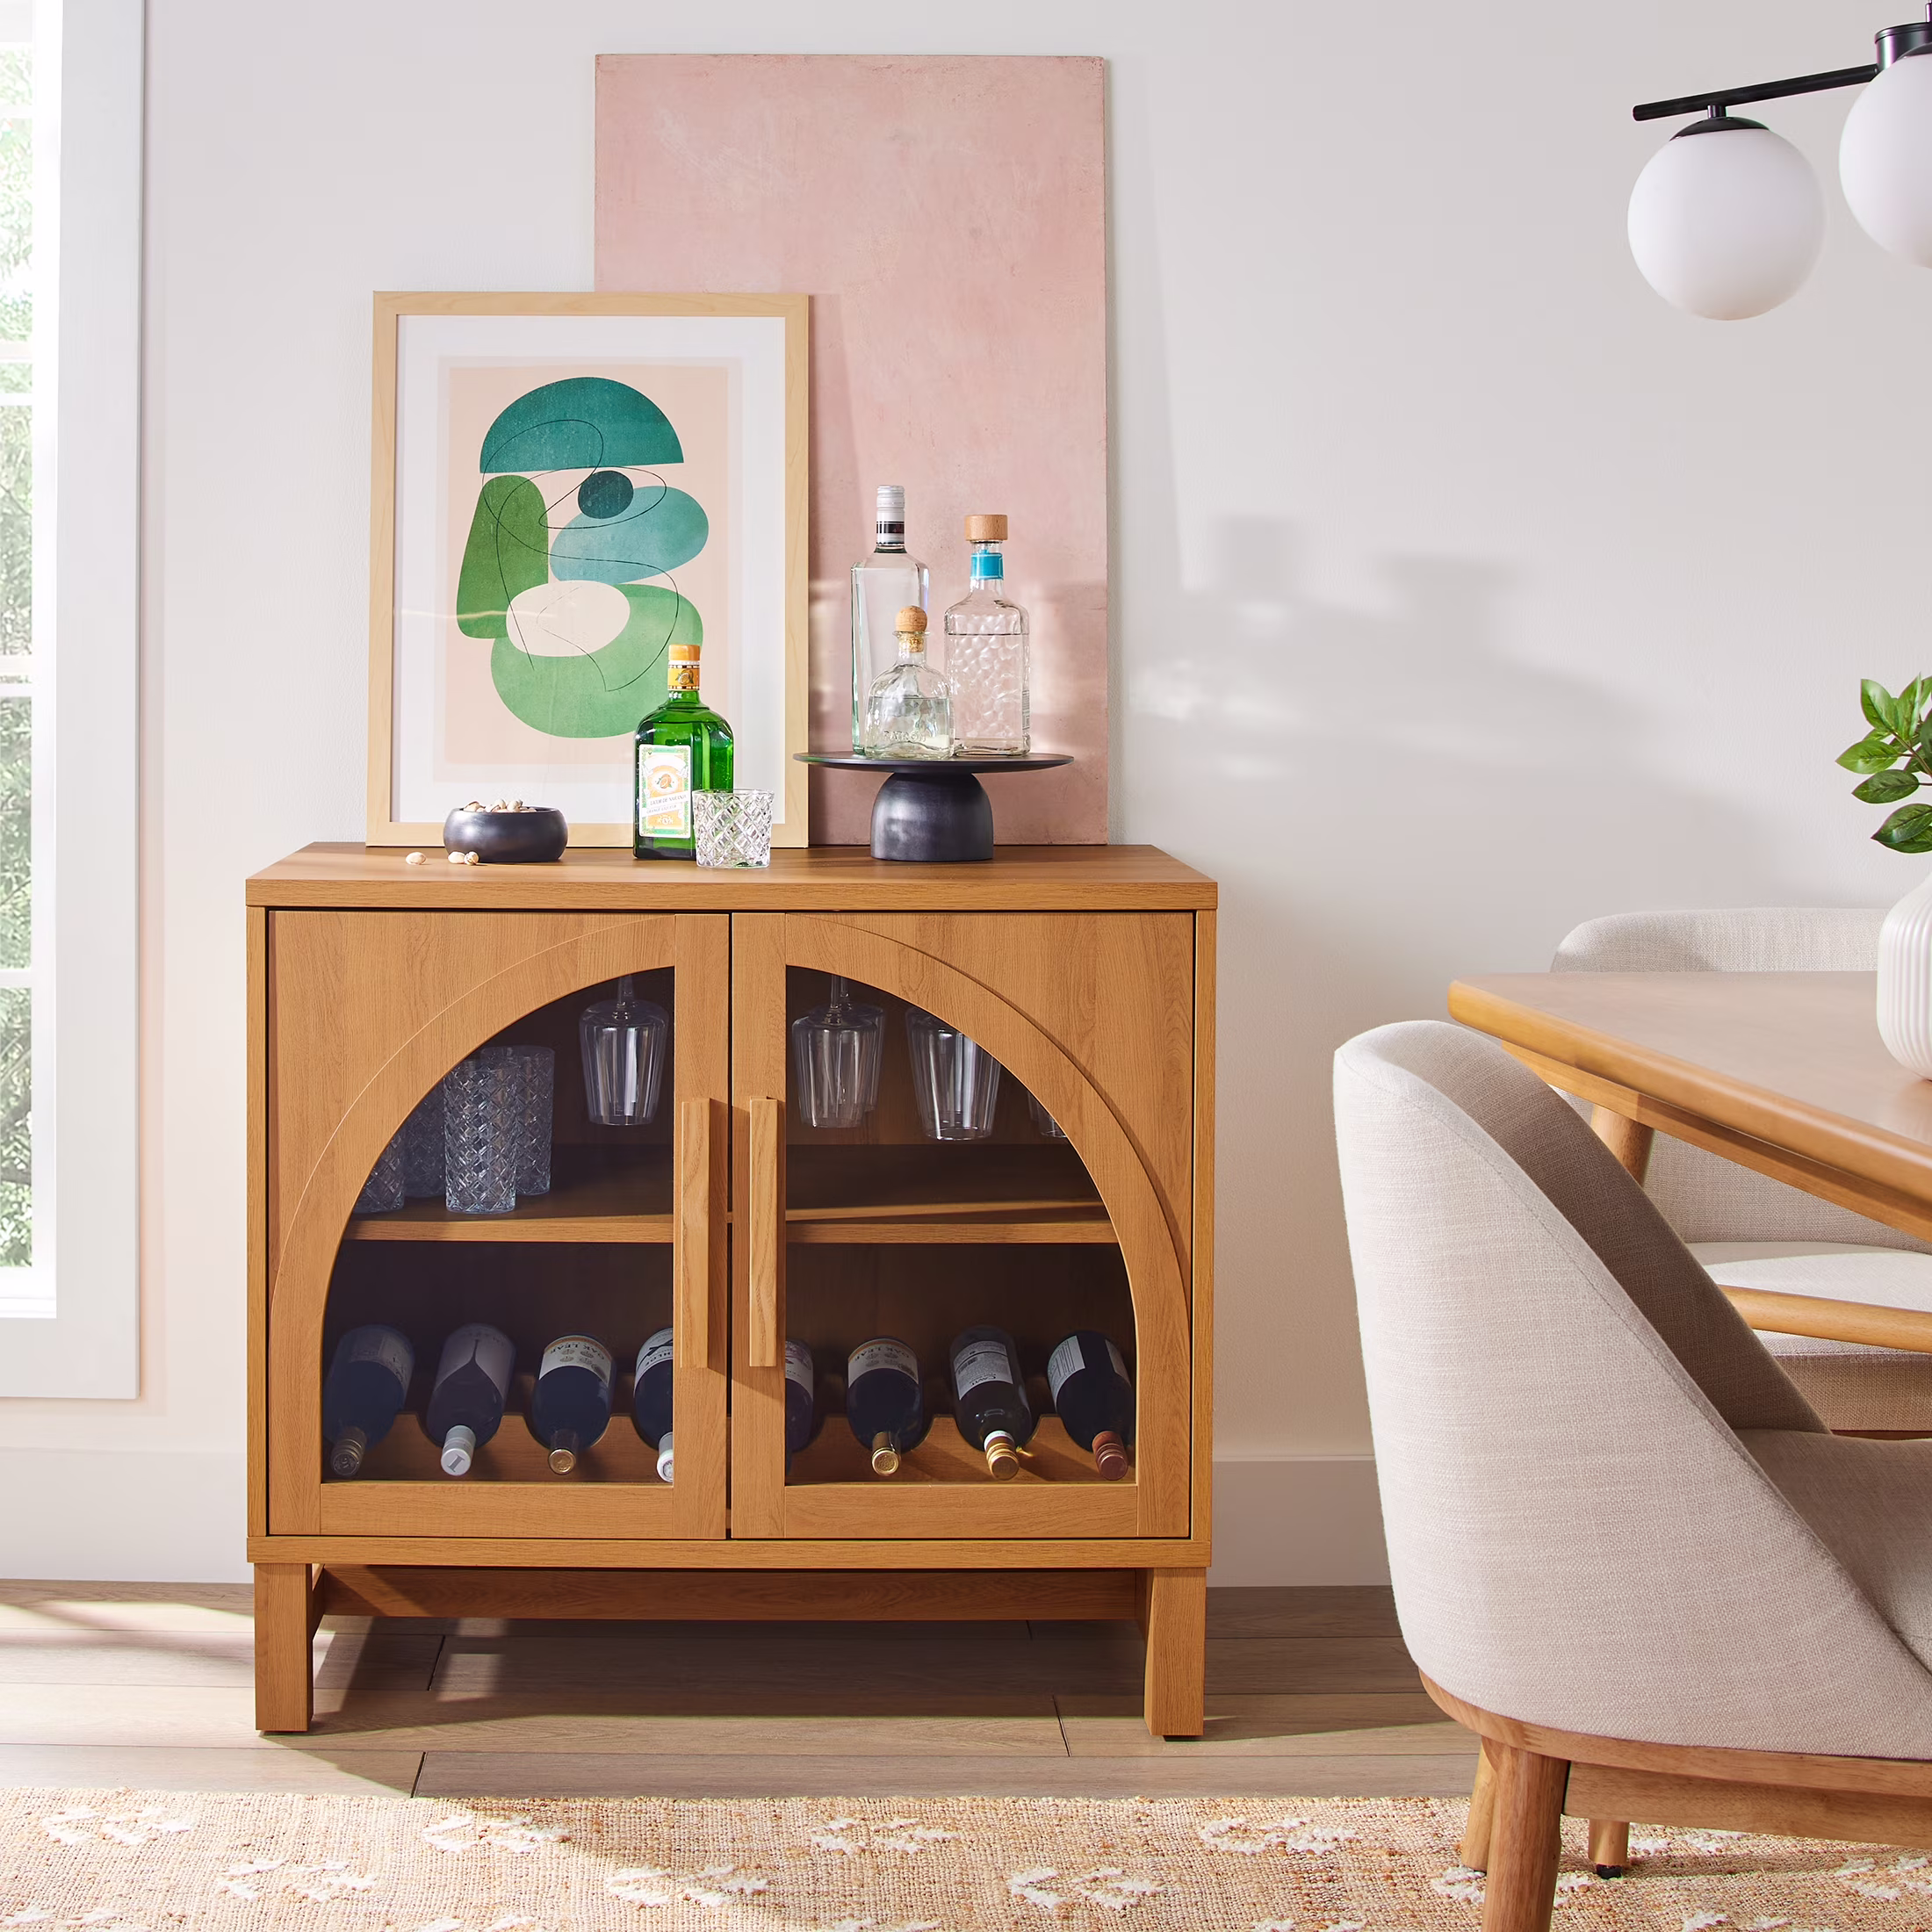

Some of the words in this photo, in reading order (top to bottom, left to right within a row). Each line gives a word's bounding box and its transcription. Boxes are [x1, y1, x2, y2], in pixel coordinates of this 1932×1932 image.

[550, 1342, 580, 1355] LEAF
[583, 1344, 605, 1360] OAK
[854, 1345, 881, 1361] LEAF
[886, 1346, 910, 1359] OAK
